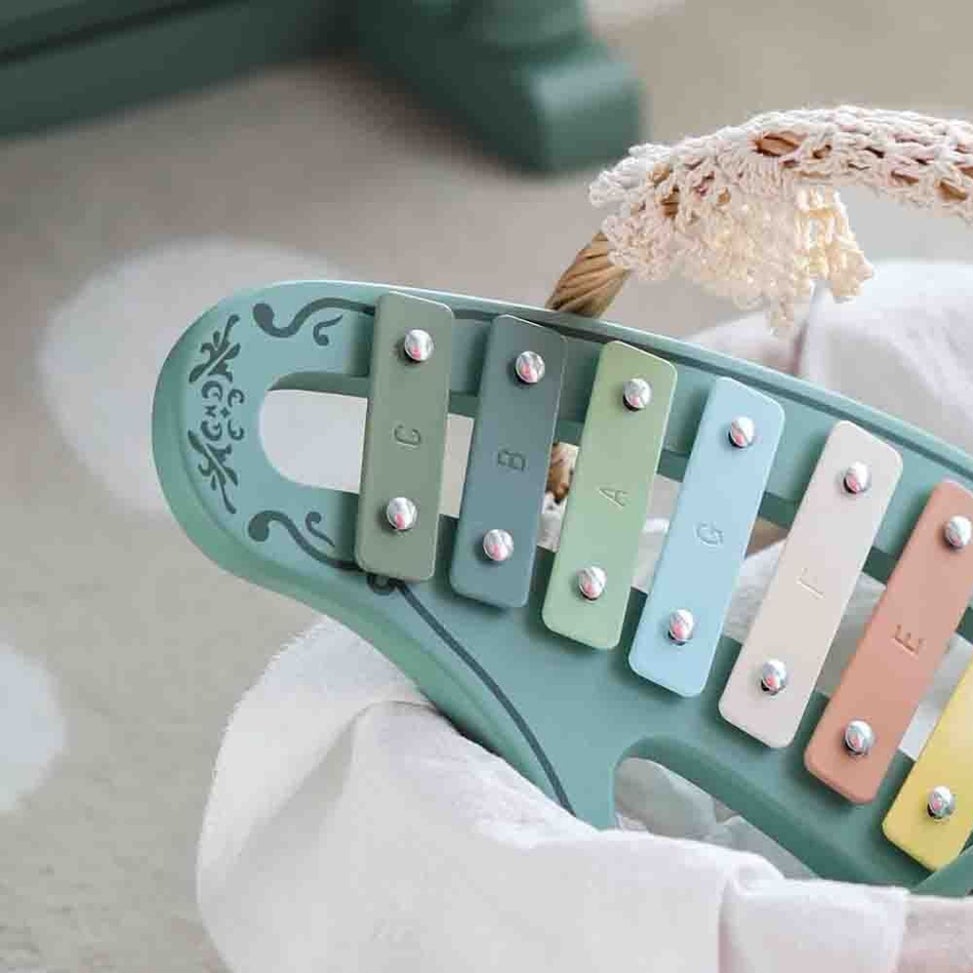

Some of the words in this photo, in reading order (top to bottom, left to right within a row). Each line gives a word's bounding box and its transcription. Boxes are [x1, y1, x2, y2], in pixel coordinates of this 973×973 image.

[393, 424, 422, 449] C
[496, 450, 527, 472] B
[598, 485, 630, 509] A
[695, 522, 725, 548] G
[894, 624, 926, 658] E
